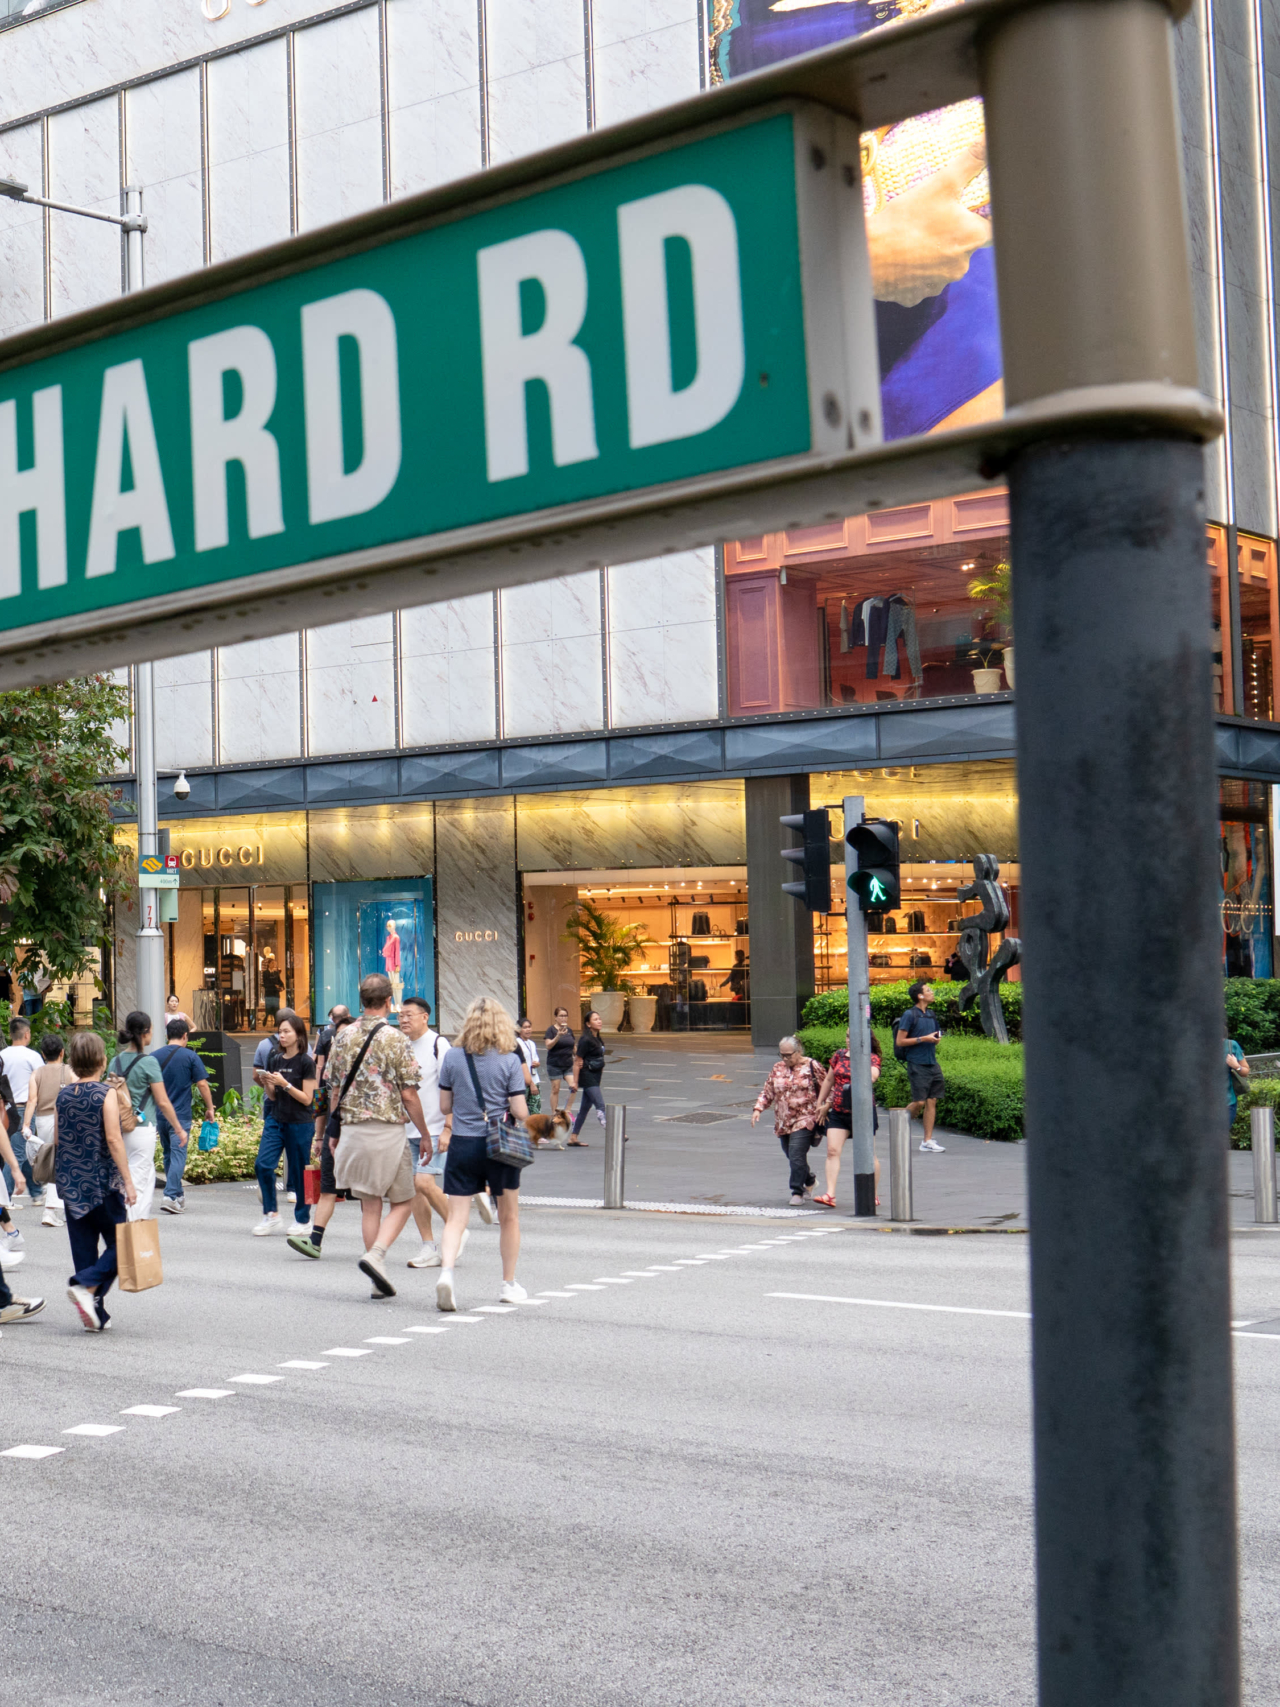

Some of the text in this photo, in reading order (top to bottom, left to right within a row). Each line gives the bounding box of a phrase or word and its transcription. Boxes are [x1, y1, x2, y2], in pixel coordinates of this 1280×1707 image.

[477, 183, 746, 484] RD
[180, 845, 264, 868] GUCCI
[455, 930, 498, 942] GUCCI
